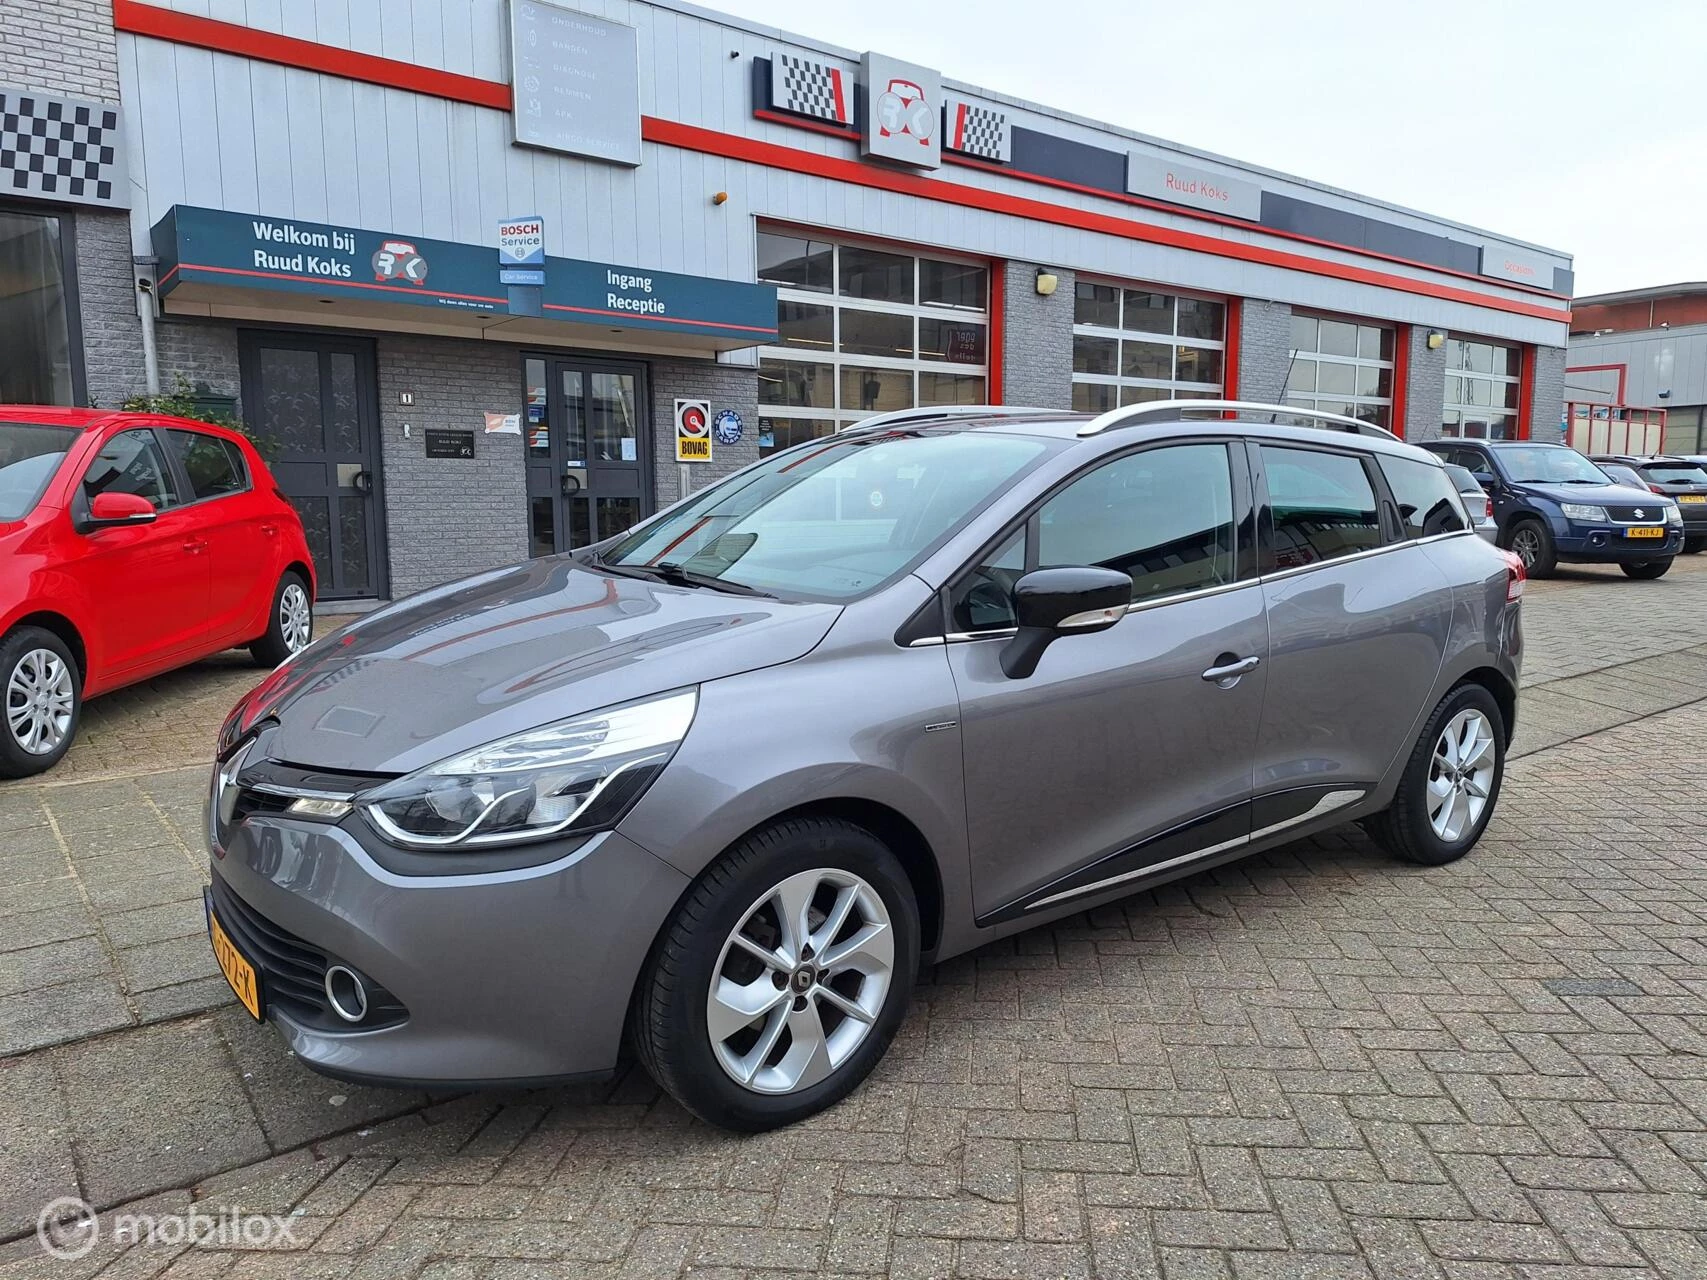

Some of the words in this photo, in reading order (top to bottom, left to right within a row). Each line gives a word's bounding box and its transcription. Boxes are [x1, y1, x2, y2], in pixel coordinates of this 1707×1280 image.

[552, 40, 589, 56] BANDEN
[1166, 172, 1196, 194] Ruud
[1200, 182, 1228, 202] Koks
[253, 221, 329, 248] Welkom
[333, 231, 355, 255] bij
[501, 223, 540, 236] BOSCH
[501, 236, 540, 247] Service
[254, 249, 303, 273] Ruud
[307, 255, 352, 278] Koks
[607, 269, 652, 293] Ingang
[607, 292, 665, 315] Receptie
[681, 441, 708, 455] BOVAG
